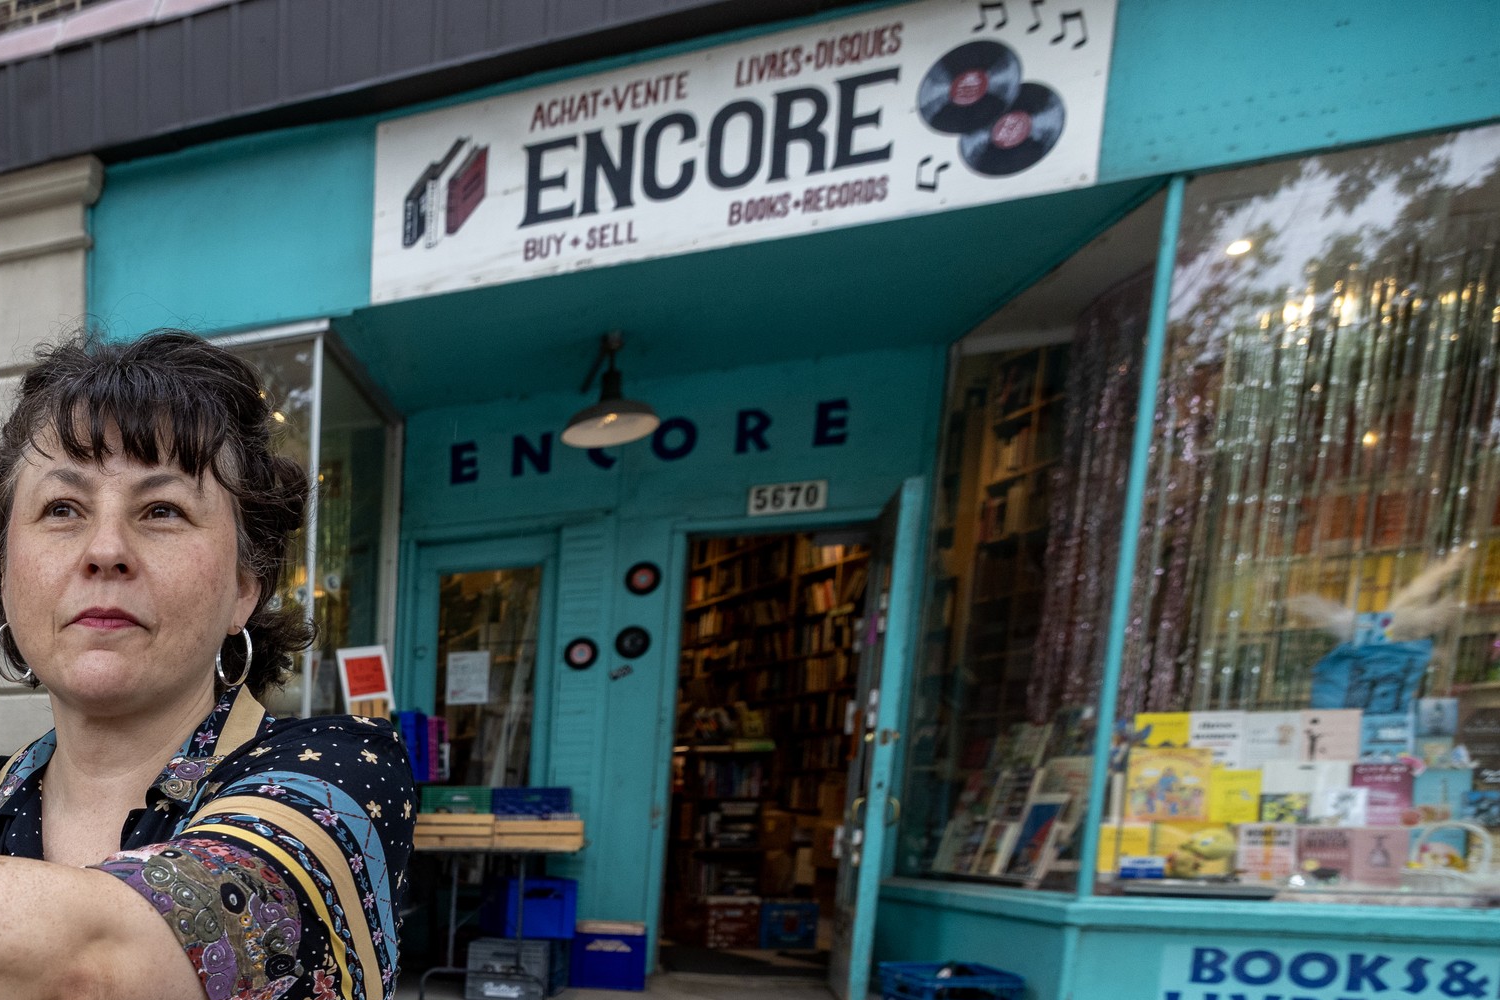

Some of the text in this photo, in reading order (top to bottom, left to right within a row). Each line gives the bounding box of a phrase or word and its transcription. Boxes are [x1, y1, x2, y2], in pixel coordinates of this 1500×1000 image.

[517, 66, 901, 229] ENCORE
[523, 220, 638, 262] BUY SELL
[753, 483, 820, 511] 5670
